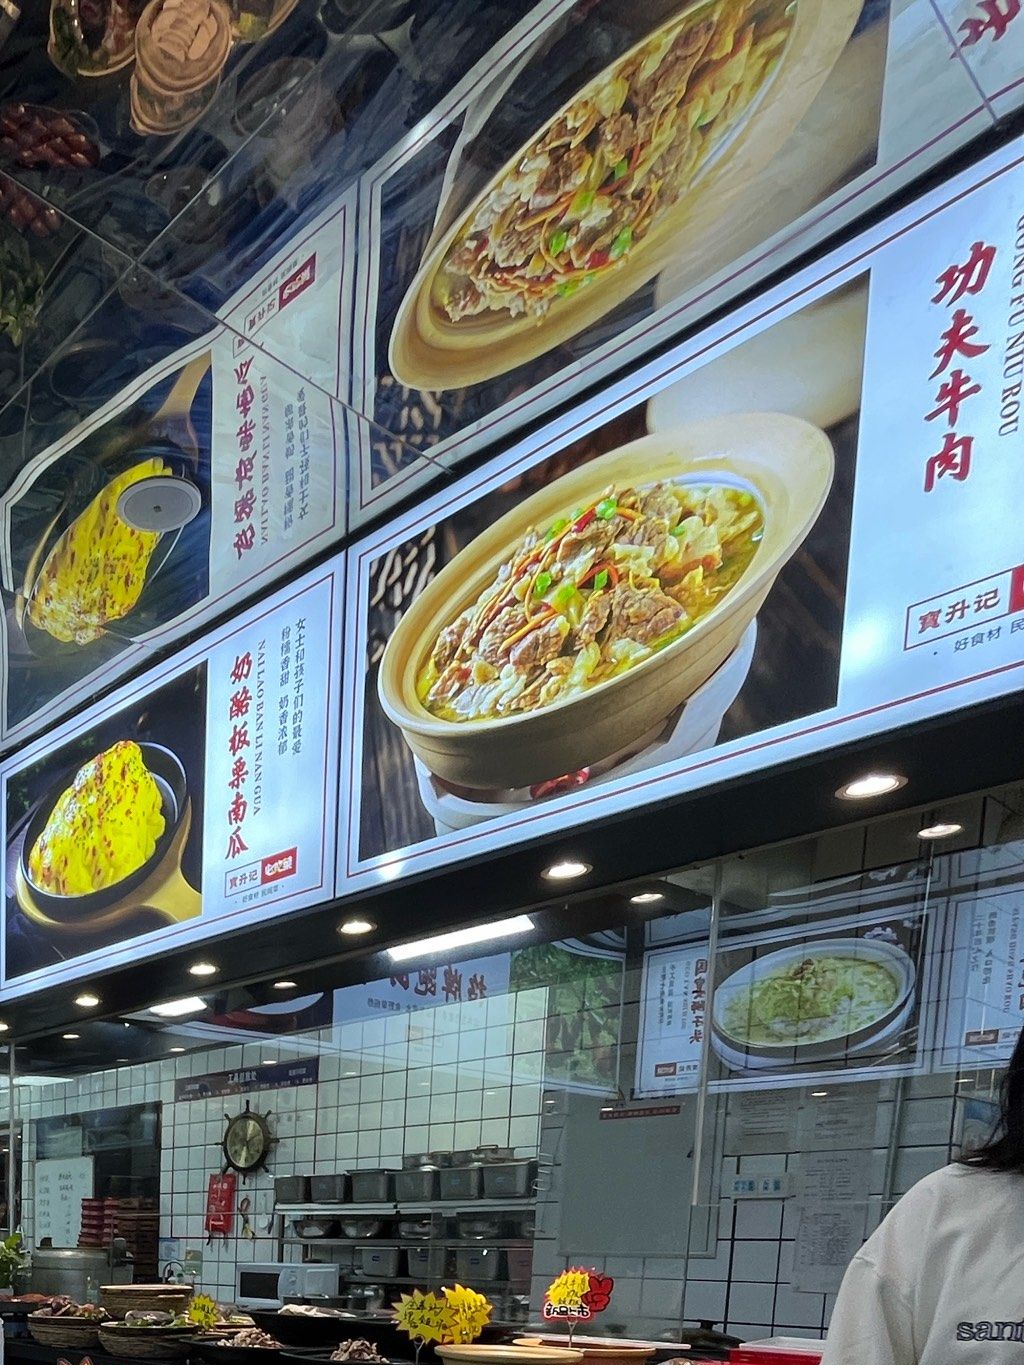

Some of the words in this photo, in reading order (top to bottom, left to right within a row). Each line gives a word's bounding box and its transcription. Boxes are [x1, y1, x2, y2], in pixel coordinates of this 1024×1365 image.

[923, 240, 997, 493] 功夫牛肉
[998, 381, 1023, 437] ROU
[292, 617, 307, 756] 女士和孩子们的最爱
[953, 626, 1002, 653] 好食材
[225, 651, 253, 860] 奶酪板栗南瓜
[545, 1302, 590, 1317] 新品上市
